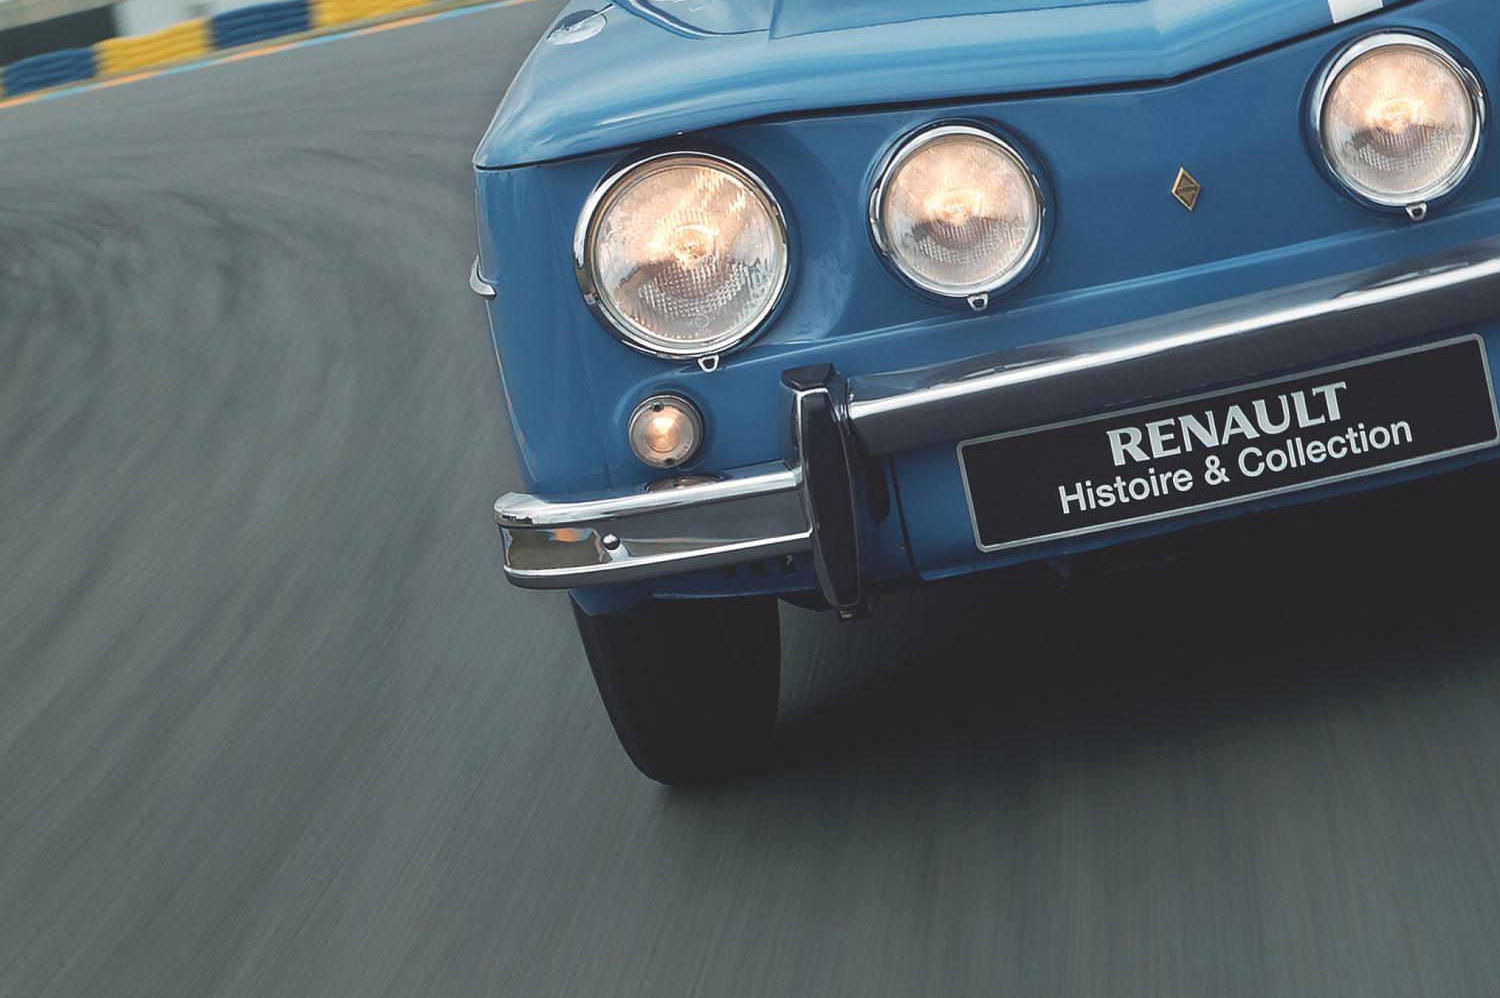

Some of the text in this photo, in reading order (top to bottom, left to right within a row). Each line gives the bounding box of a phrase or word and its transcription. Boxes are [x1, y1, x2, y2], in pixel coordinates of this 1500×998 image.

[1058, 420, 1413, 514] Histoire & Collection
[1106, 381, 1346, 466] RENAULT
